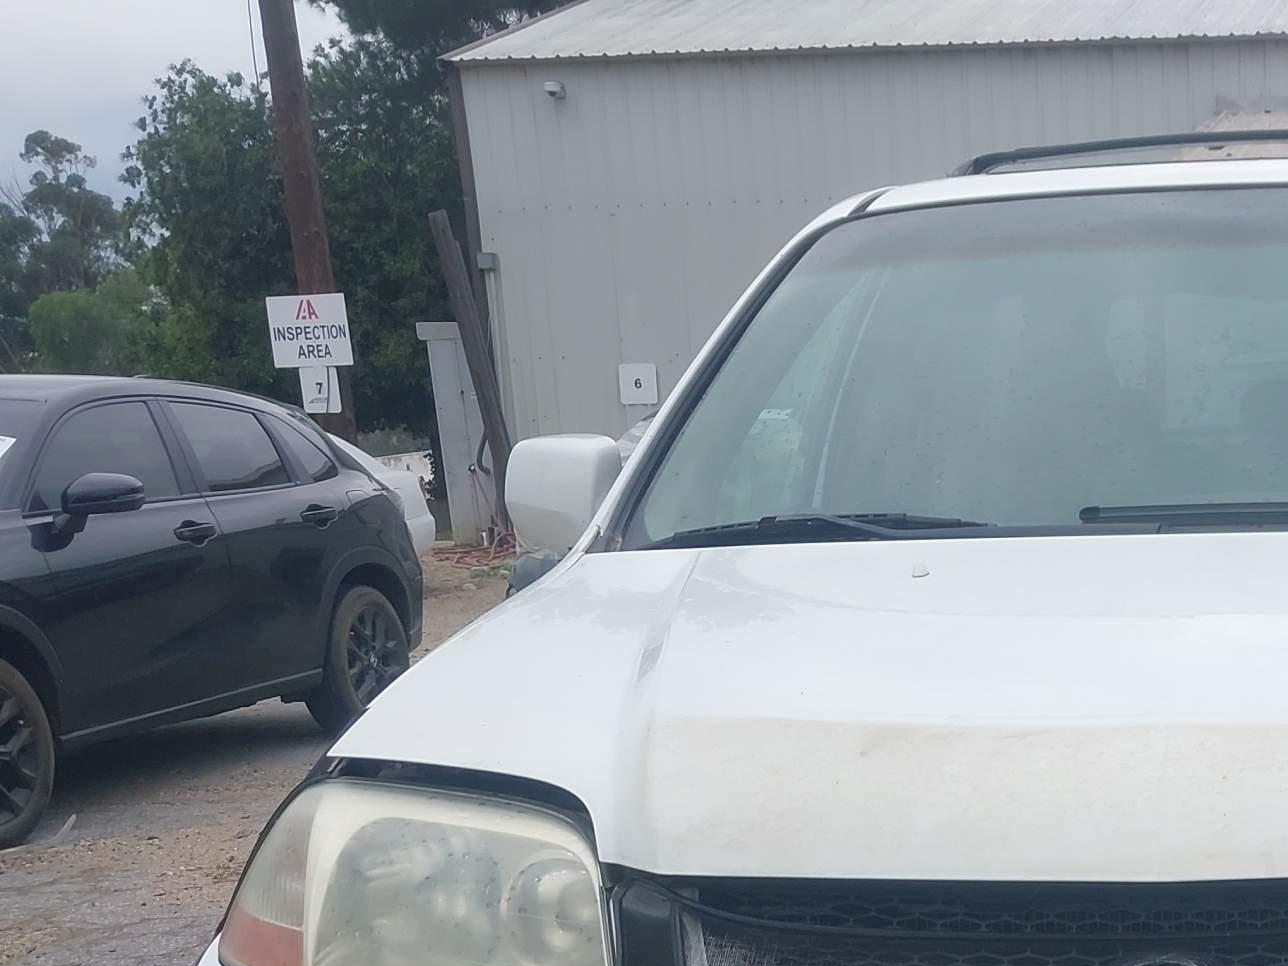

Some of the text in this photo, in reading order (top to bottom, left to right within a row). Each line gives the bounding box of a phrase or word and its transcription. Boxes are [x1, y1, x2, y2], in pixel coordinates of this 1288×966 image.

[273, 324, 347, 342] INSPECTION
[298, 344, 332, 359] AREA
[315, 382, 323, 395] 7
[634, 378, 642, 389] 6
